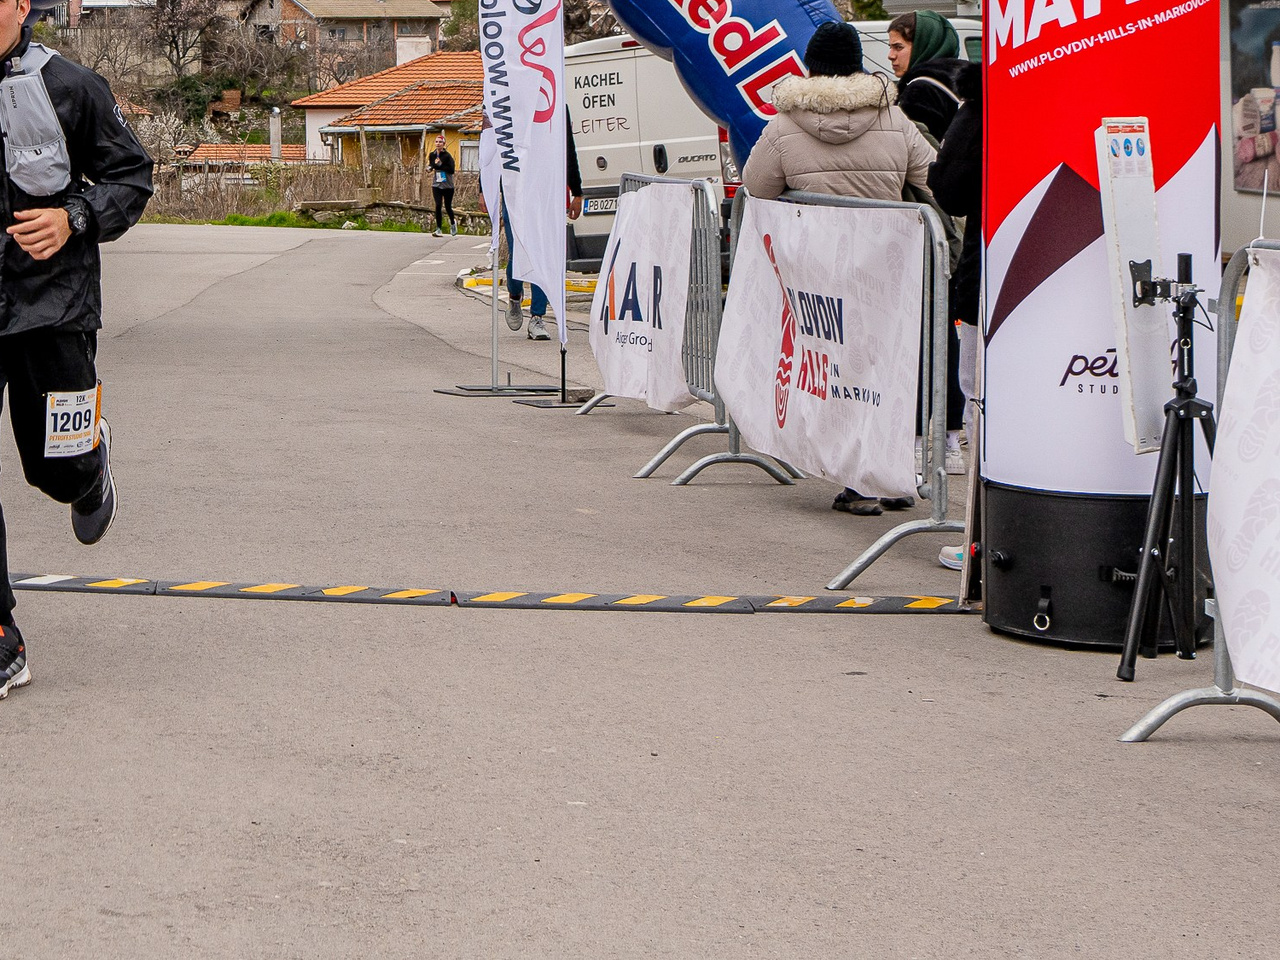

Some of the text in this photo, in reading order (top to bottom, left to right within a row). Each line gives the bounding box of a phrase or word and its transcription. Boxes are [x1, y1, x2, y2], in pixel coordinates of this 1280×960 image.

[574, 72, 623, 89] KACHEL
[8, 85, 18, 109] KIPRUN
[582, 93, 616, 109] ÖFEN
[571, 116, 630, 135] LEITER
[678, 154, 716, 163] DUCATO
[830, 362, 840, 378] IN
[50, 408, 92, 433] 1209
